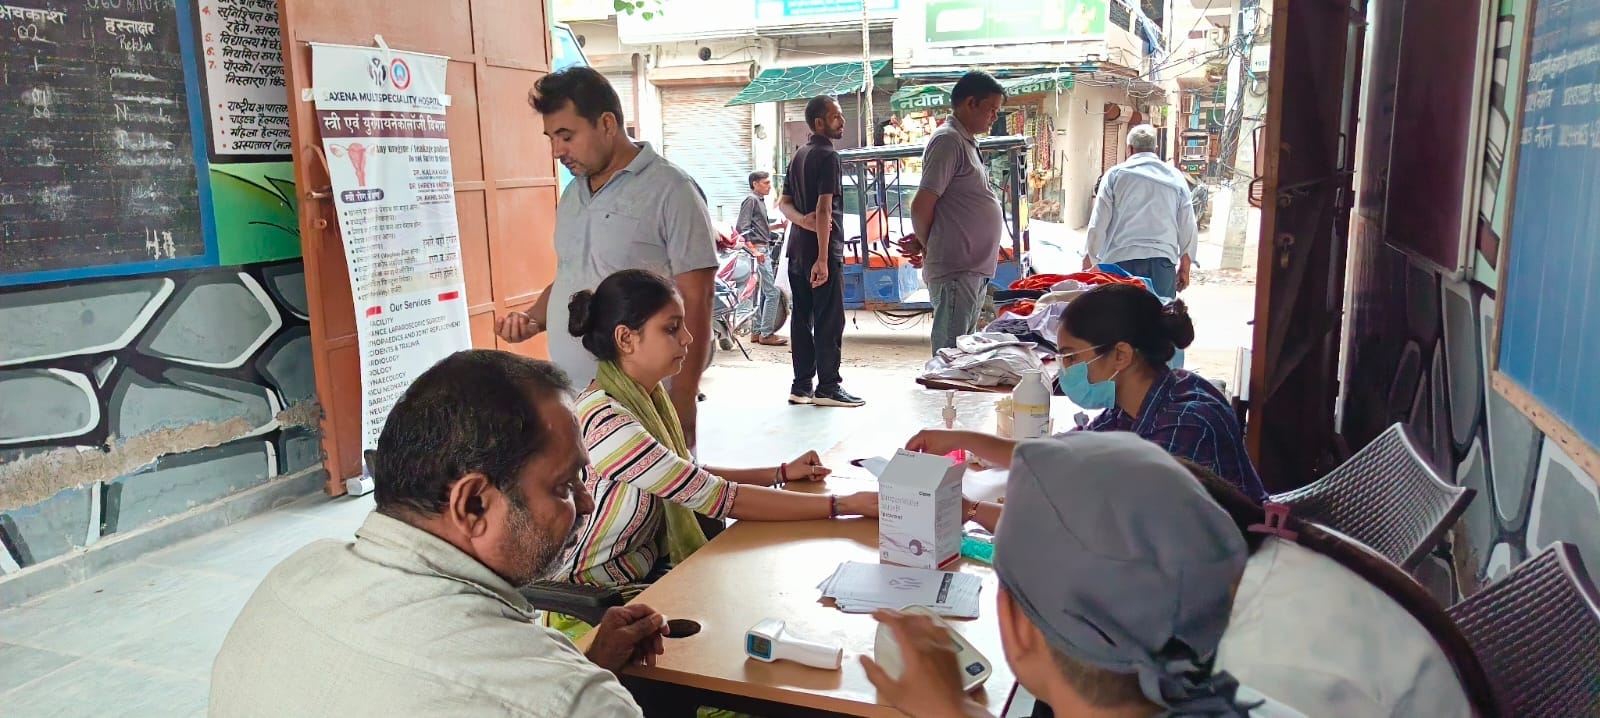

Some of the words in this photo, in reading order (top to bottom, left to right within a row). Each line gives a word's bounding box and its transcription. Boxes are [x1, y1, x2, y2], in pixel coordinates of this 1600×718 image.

[104, 17, 155, 36] हस्ताक्षर
[222, 46, 260, 61] नियमित
[225, 72, 267, 88] निस्तारण
[324, 92, 358, 101] AXENA
[900, 93, 944, 110] नवीन
[227, 98, 256, 114] राष्ट्रीय
[323, 112, 341, 131] स्त्री
[344, 113, 360, 133] एवं
[230, 125, 258, 138] महिला
[232, 140, 272, 150] अस्पताल
[390, 303, 403, 313] Our
[404, 299, 432, 310] Services
